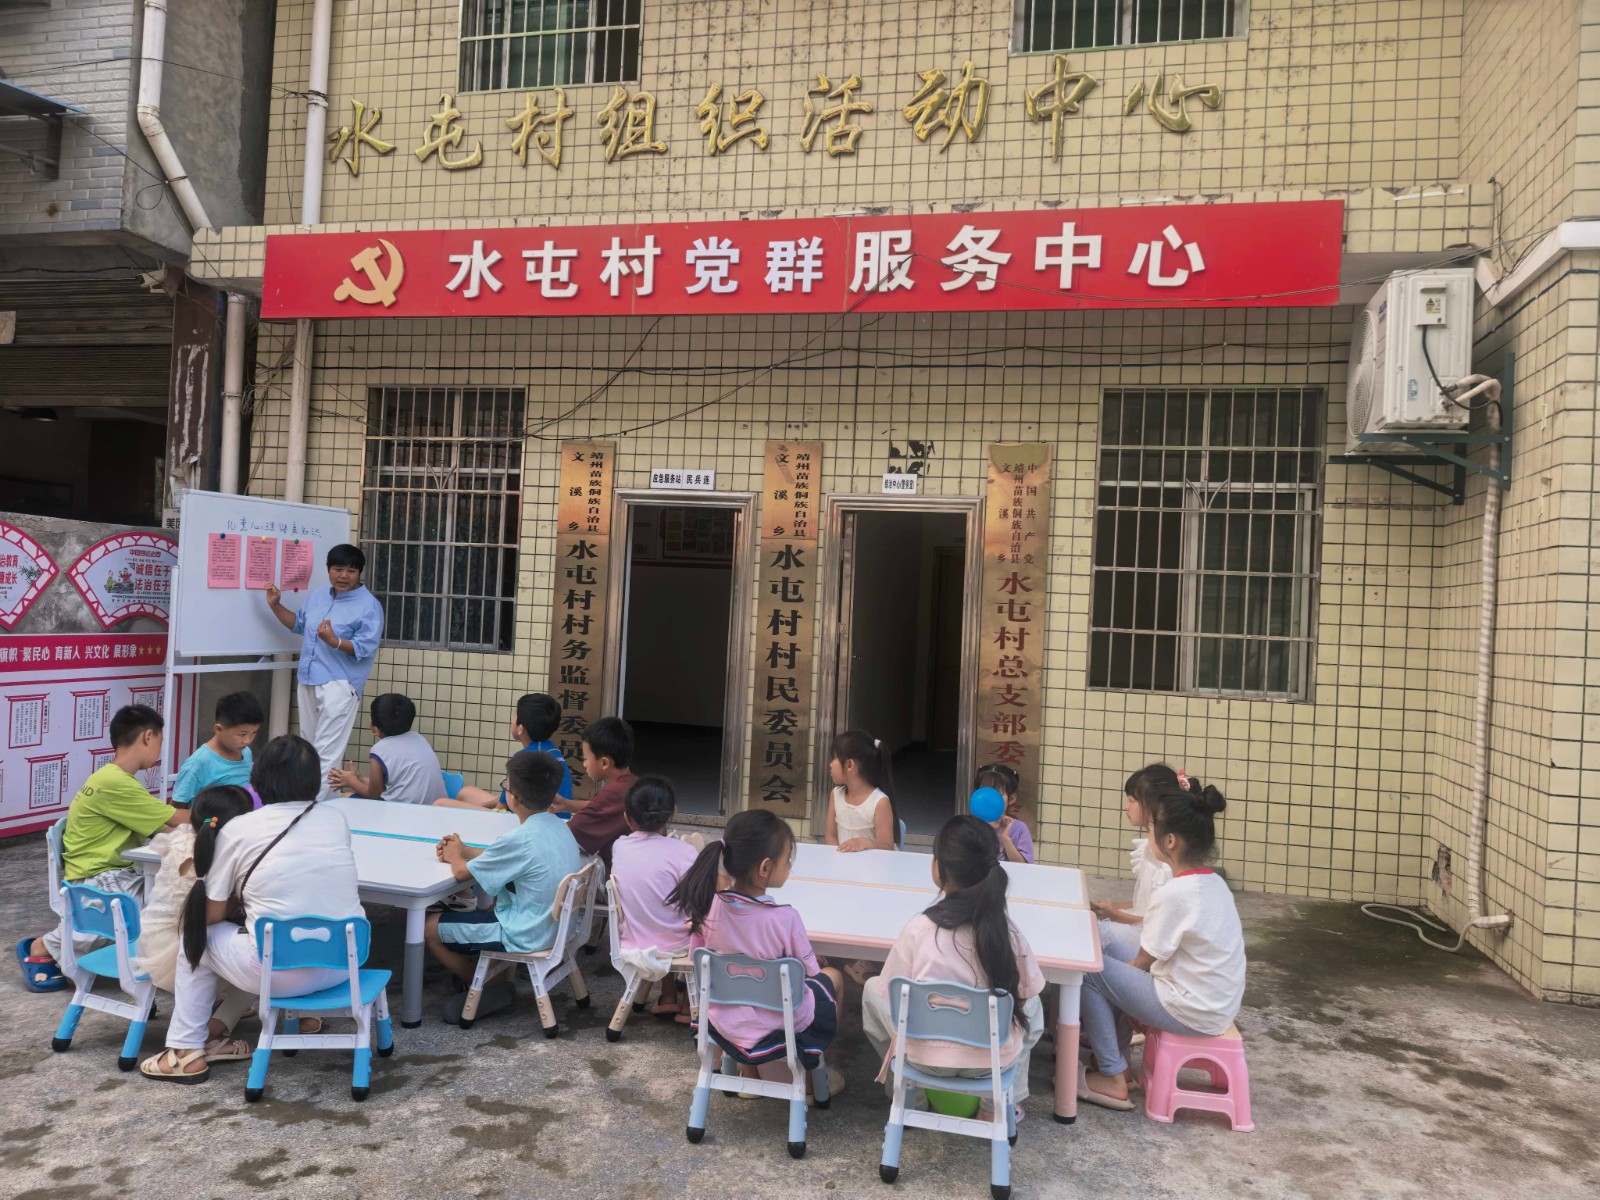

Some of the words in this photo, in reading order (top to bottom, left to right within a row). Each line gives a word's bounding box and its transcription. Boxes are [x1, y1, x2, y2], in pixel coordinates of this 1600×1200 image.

[329, 54, 1222, 177] 水屯村组织活动中心
[445, 221, 1206, 299] 水屯村党群服务中心
[568, 452, 584, 533] 文溪乡
[587, 452, 604, 533] 靖州苗族侗族自治县
[652, 473, 681, 484] 应急服务站
[686, 474, 710, 485] 民兵连
[773, 453, 790, 537] 文溪乡
[793, 453, 810, 537] 靖州苗族侗族自治县
[996, 463, 1011, 564] 文溪乡
[1010, 464, 1025, 565] 靖州苗族侗族自治县
[1024, 464, 1038, 565] 中国共产党
[22, 646, 50, 662] 聚民心
[55, 645, 81, 661] 育新人
[85, 644, 110, 659] 兴文化
[113, 643, 137, 658] 展形象
[760, 544, 806, 803] 水屯村村民委员会
